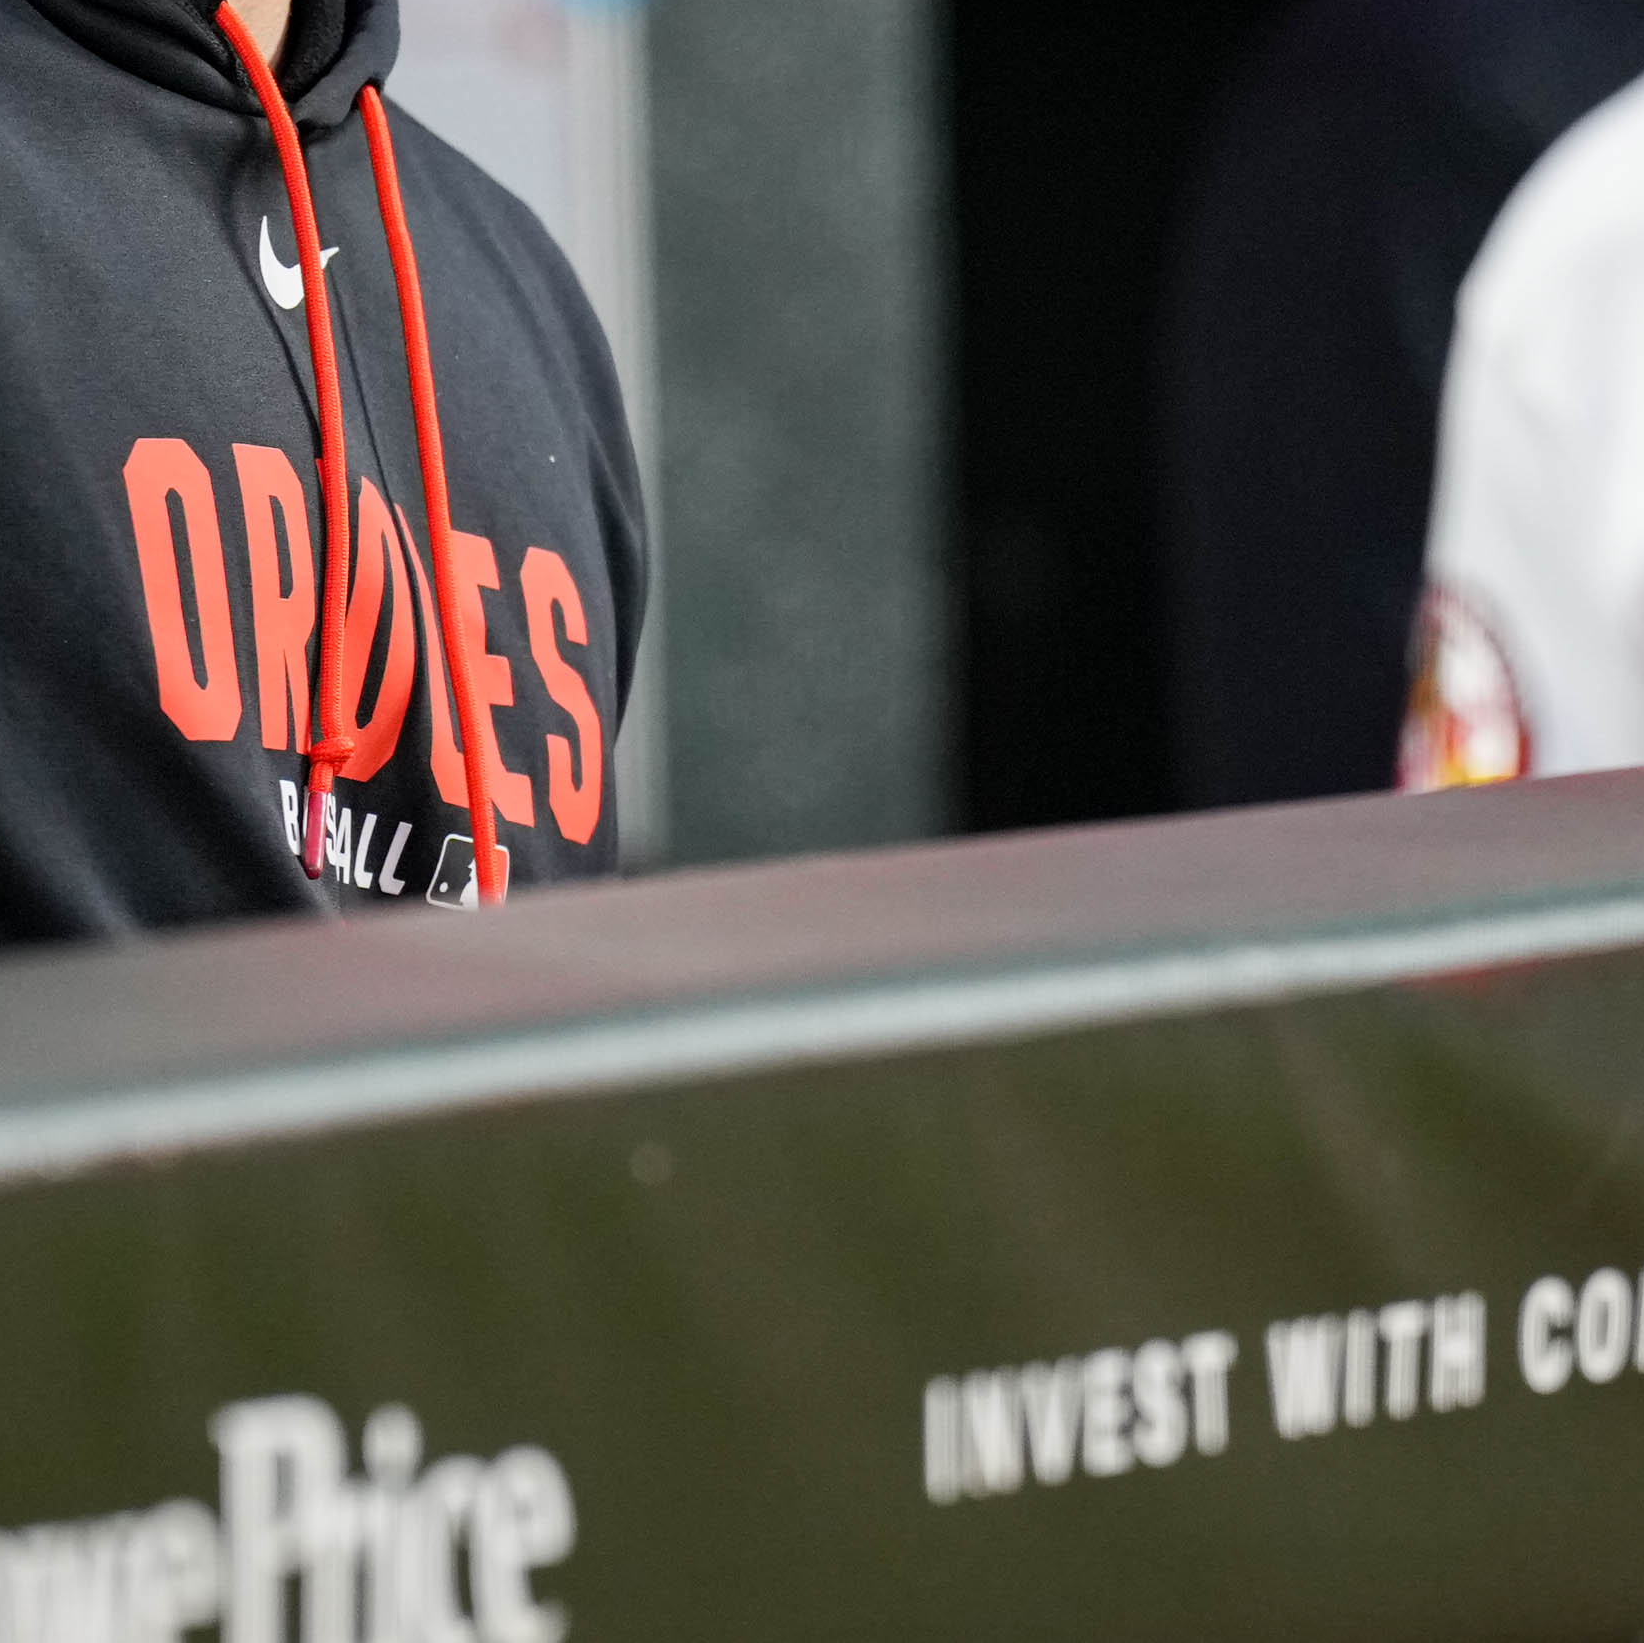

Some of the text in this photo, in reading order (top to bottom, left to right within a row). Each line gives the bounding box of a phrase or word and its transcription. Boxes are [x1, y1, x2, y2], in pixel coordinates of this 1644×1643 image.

[123, 437, 602, 845] OROLES
[923, 1330, 1239, 1506] INVEST
[1265, 1290, 1488, 1421] WITH
